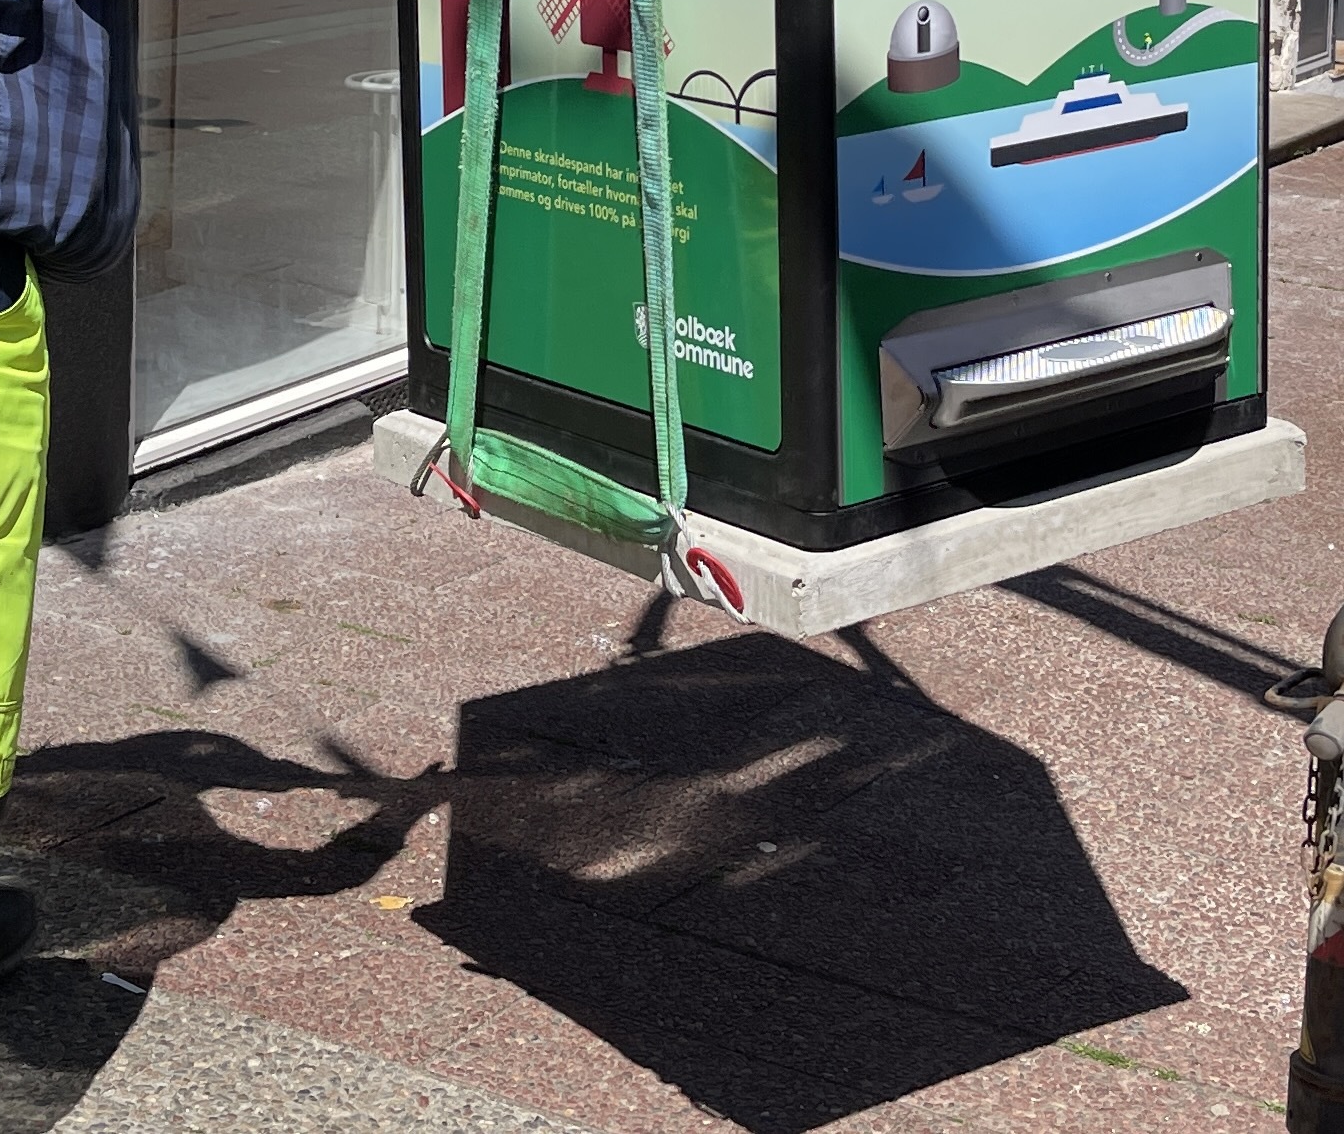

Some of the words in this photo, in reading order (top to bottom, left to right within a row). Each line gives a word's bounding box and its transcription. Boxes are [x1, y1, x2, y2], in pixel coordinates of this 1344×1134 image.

[499, 140, 532, 162] Denne
[534, 147, 603, 178] skraldespand
[605, 163, 630, 184] har
[496, 164, 555, 189] mprimator,
[557, 175, 603, 199] fortæller
[606, 184, 641, 206] hvorn
[675, 201, 698, 220] skal
[497, 185, 535, 204] ømmes
[537, 193, 552, 212] og
[554, 192, 586, 216] drives
[588, 201, 619, 224] 100%
[621, 210, 636, 229] på
[674, 314, 736, 352] olbæk
[673, 339, 754, 379] ommune
